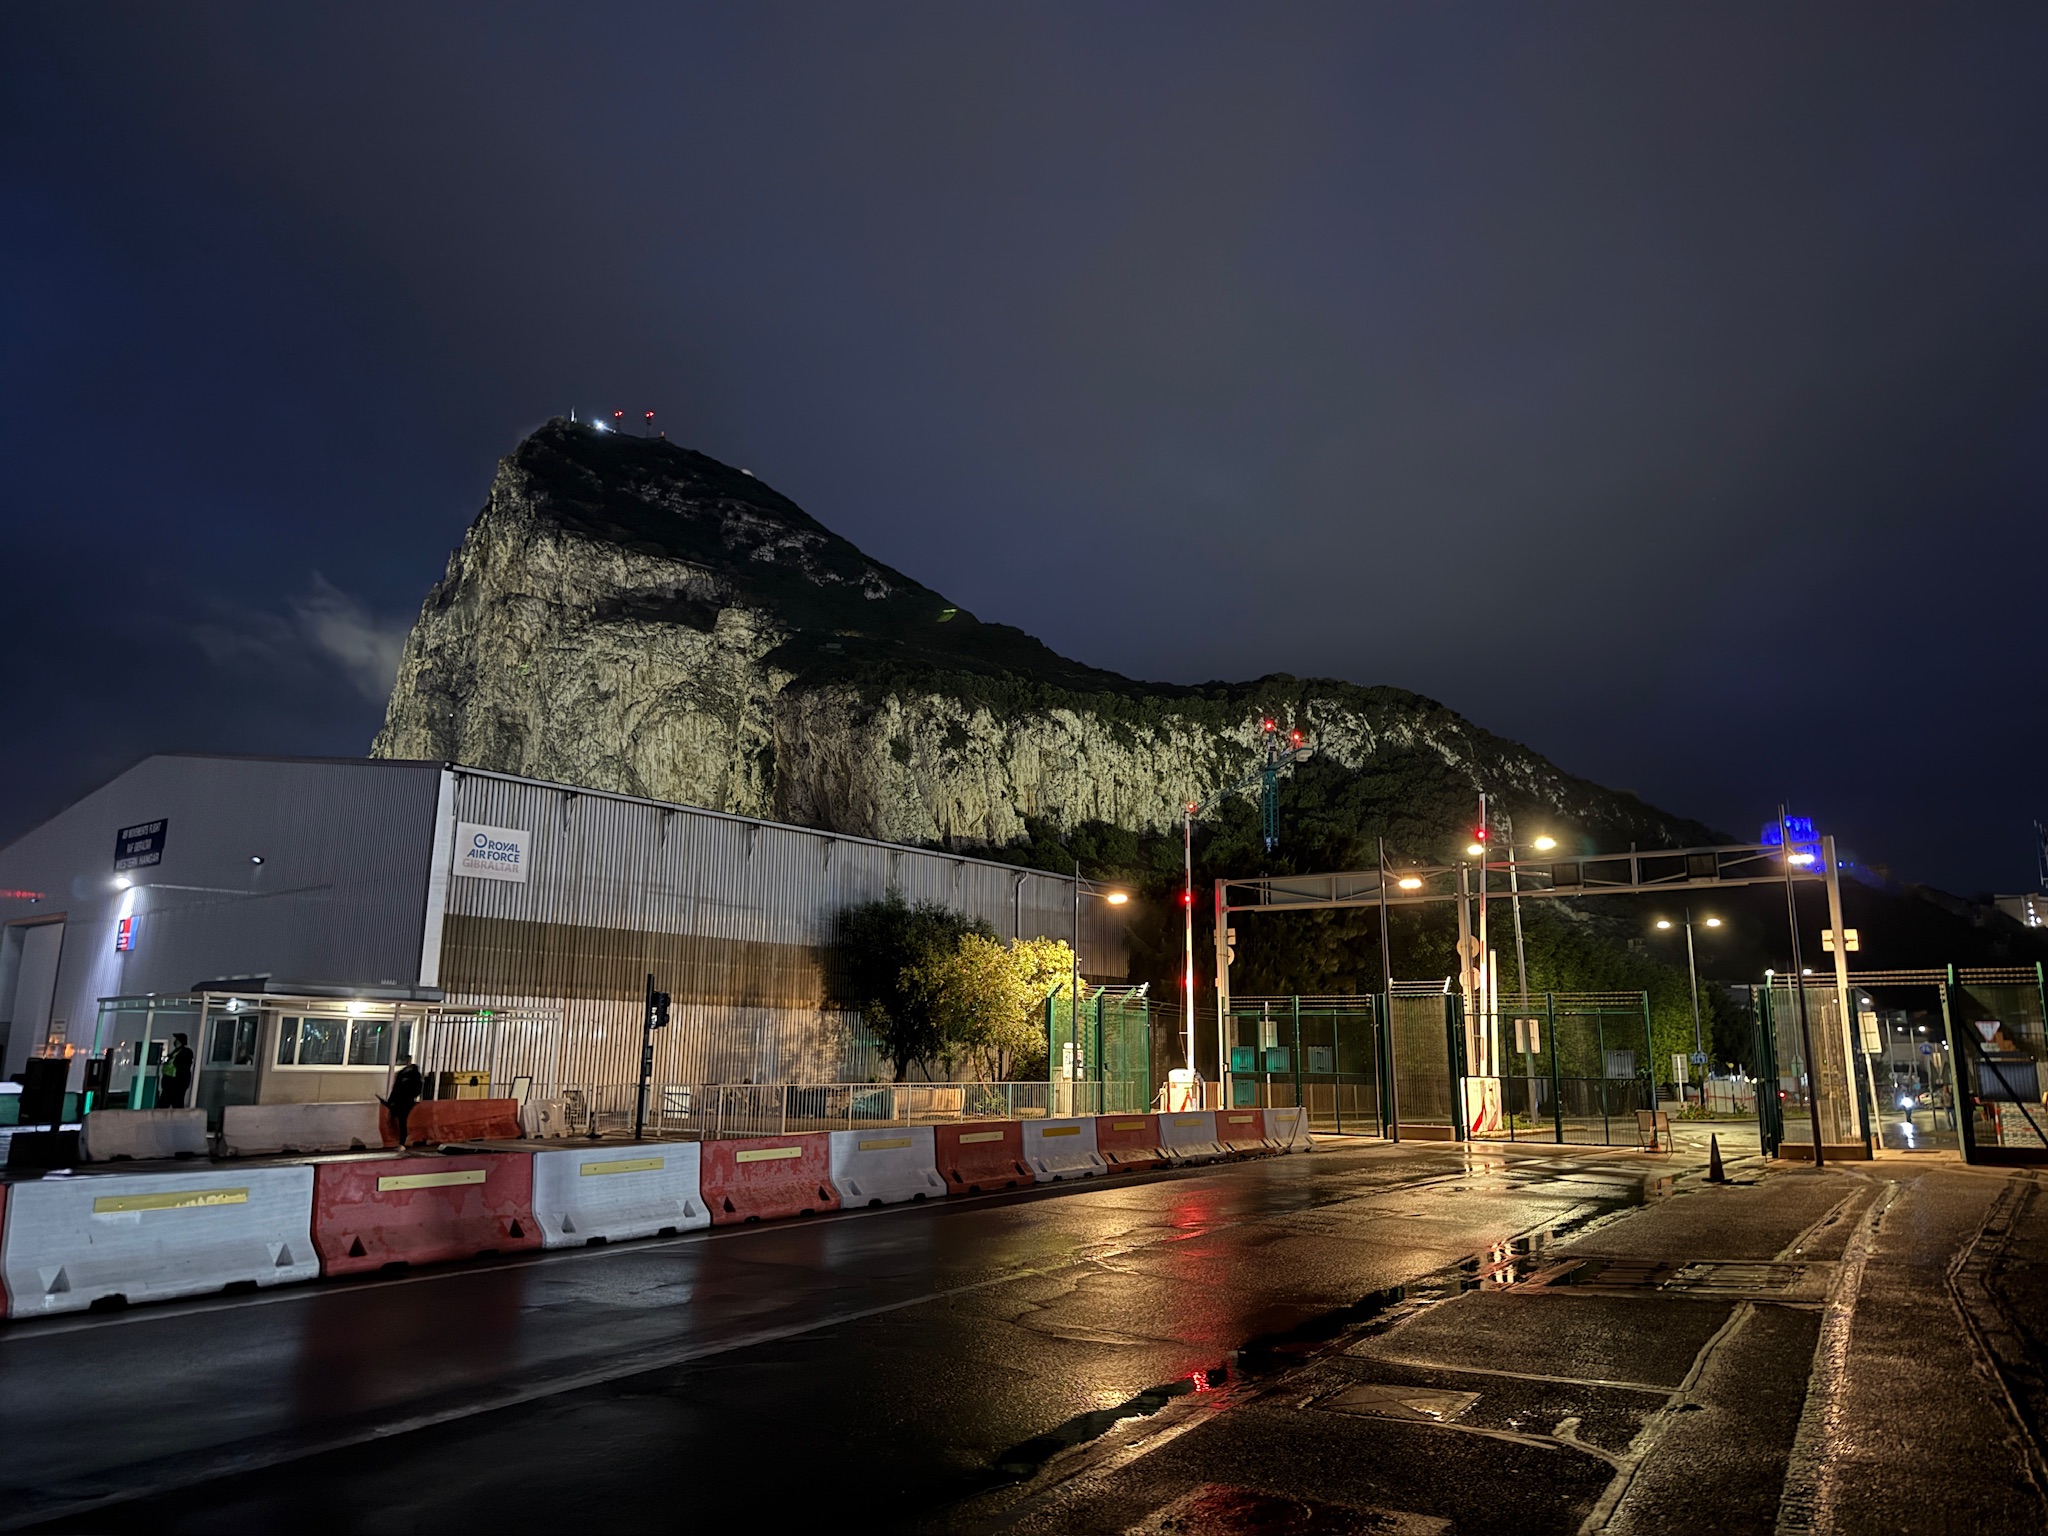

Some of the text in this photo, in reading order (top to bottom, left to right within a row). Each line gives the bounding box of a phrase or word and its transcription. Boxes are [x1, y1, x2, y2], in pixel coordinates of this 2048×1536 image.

[488, 840, 520, 853] ROYAL
[467, 849, 520, 863] AIR FORCE
[462, 858, 519, 873] GIBRALTAR
